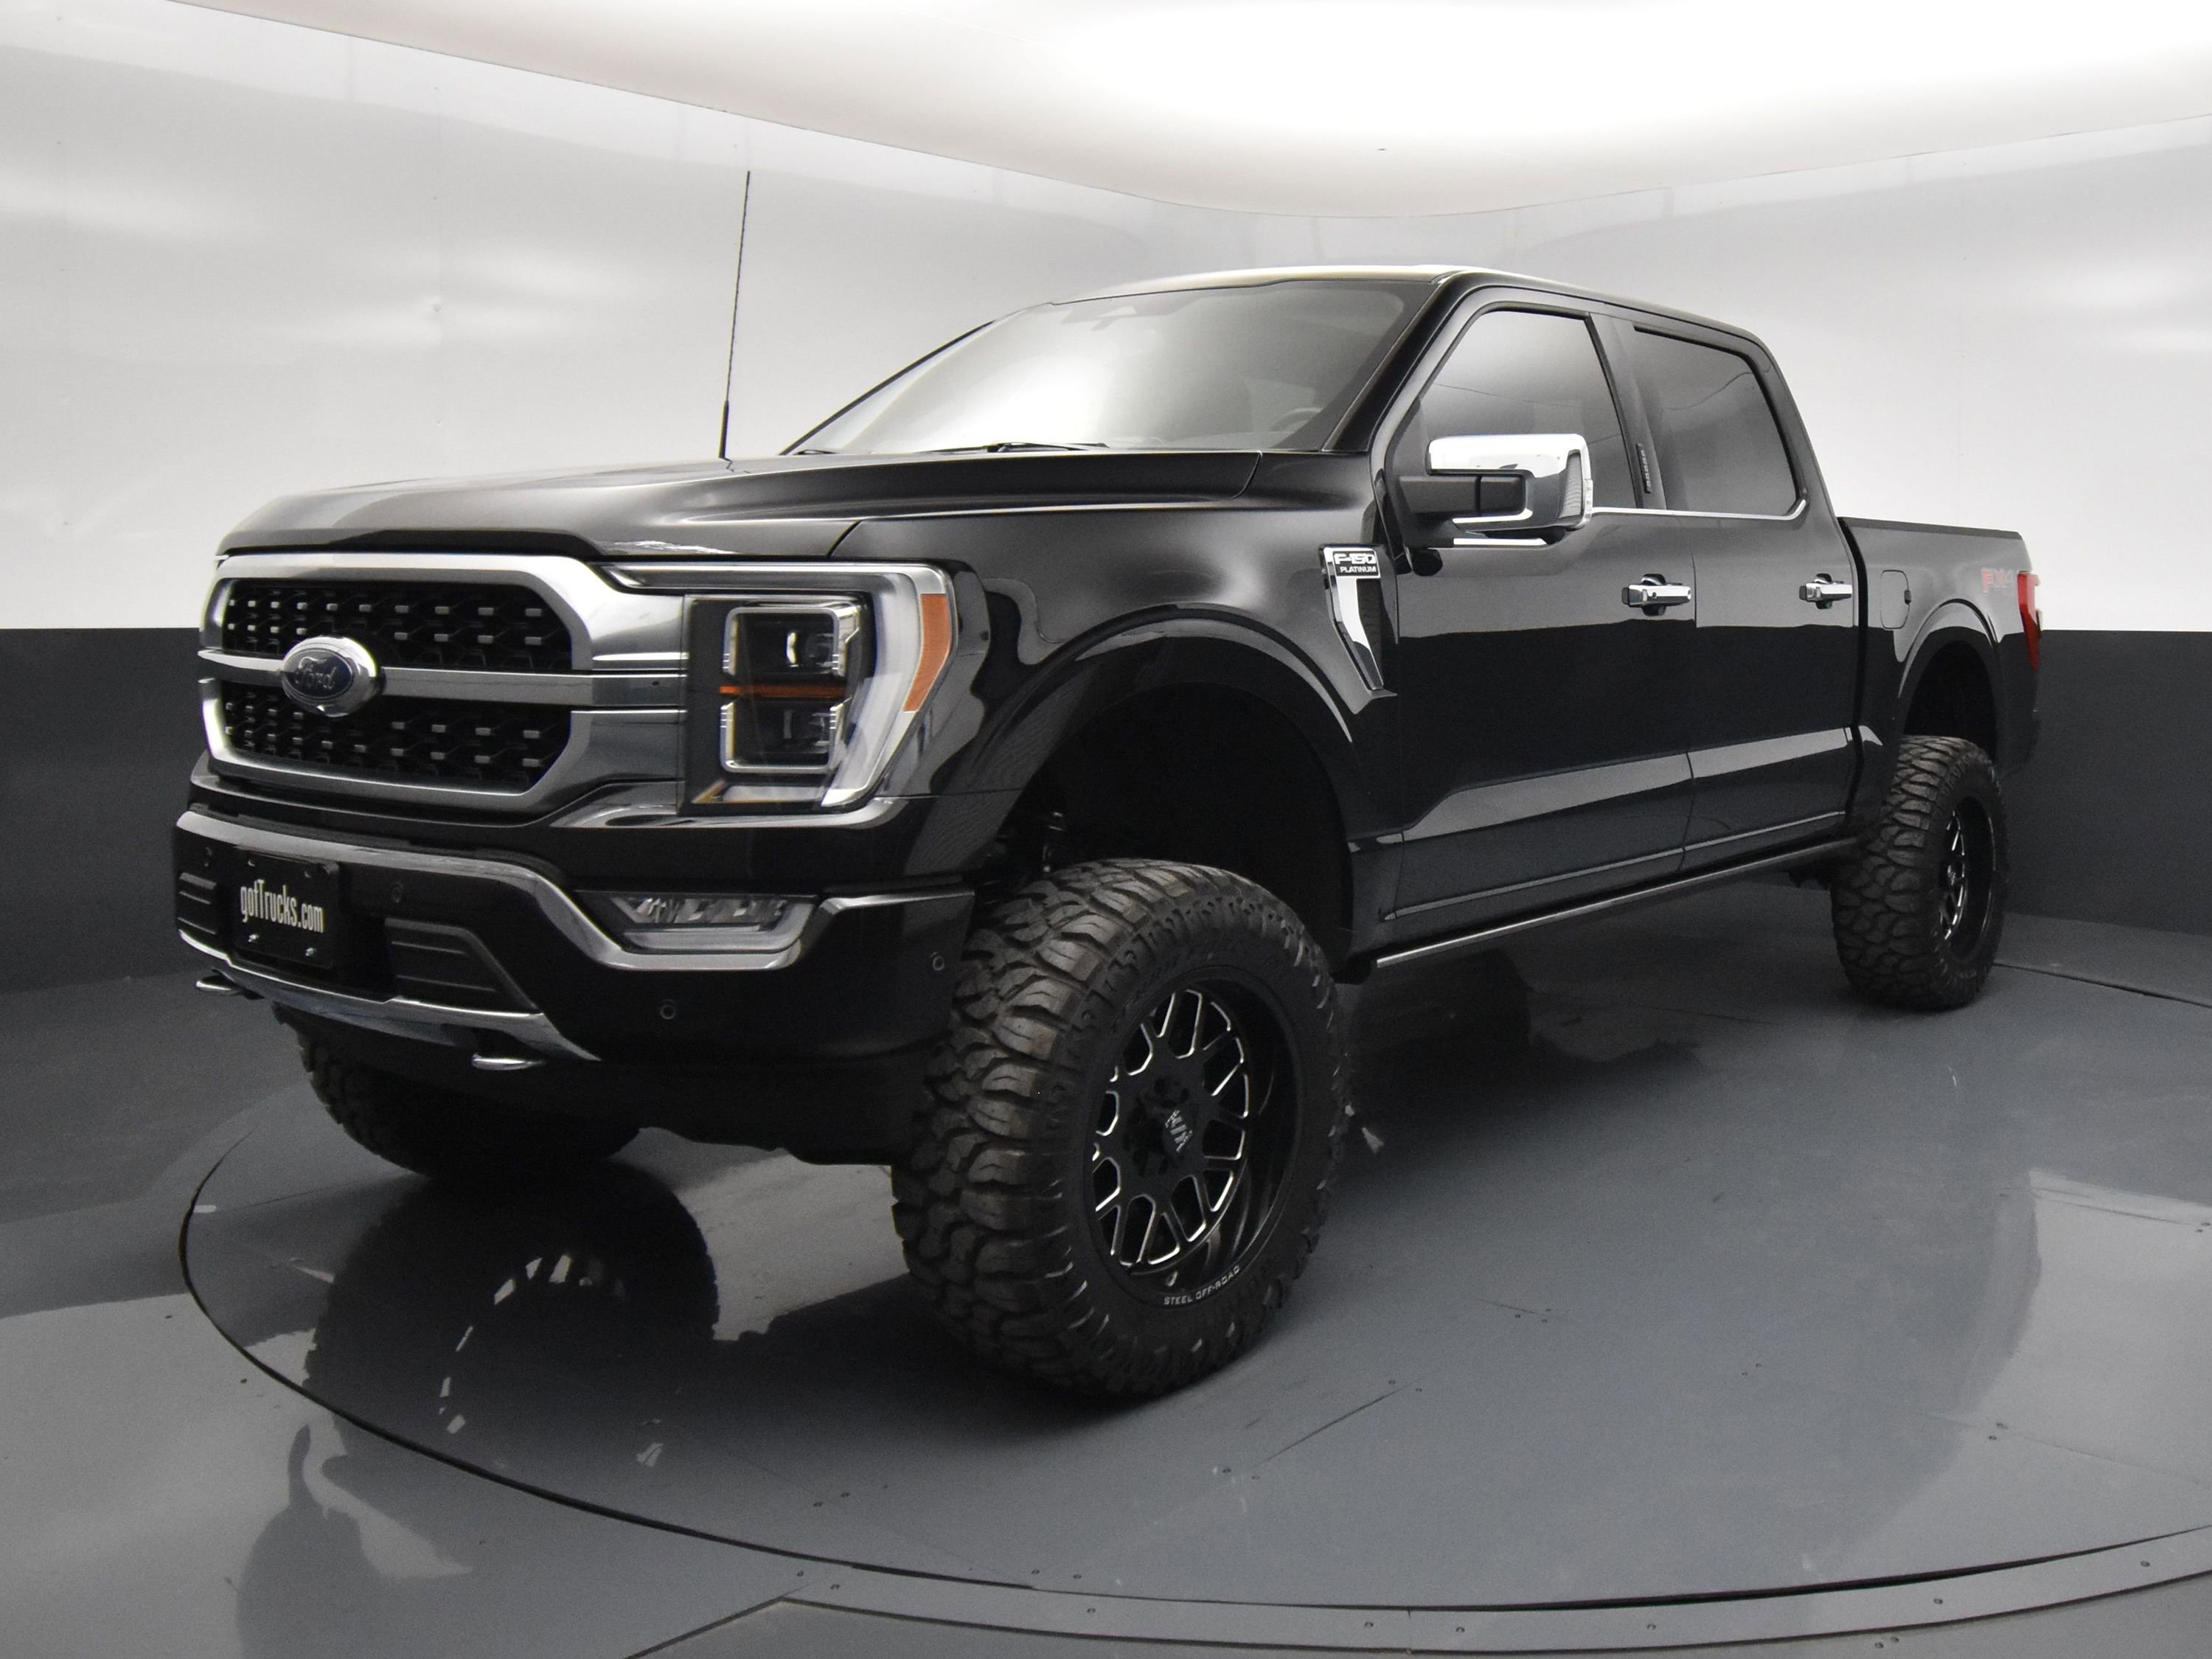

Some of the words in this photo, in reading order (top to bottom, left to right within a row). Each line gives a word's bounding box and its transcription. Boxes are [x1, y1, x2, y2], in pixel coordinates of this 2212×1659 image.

[1334, 553, 1377, 564] F-150
[294, 656, 338, 689] Ford
[240, 879, 324, 933] gotTrucks.com
[1164, 1295, 1193, 1305] STEEL
[1195, 1265, 1240, 1301] OFF-ROAD
